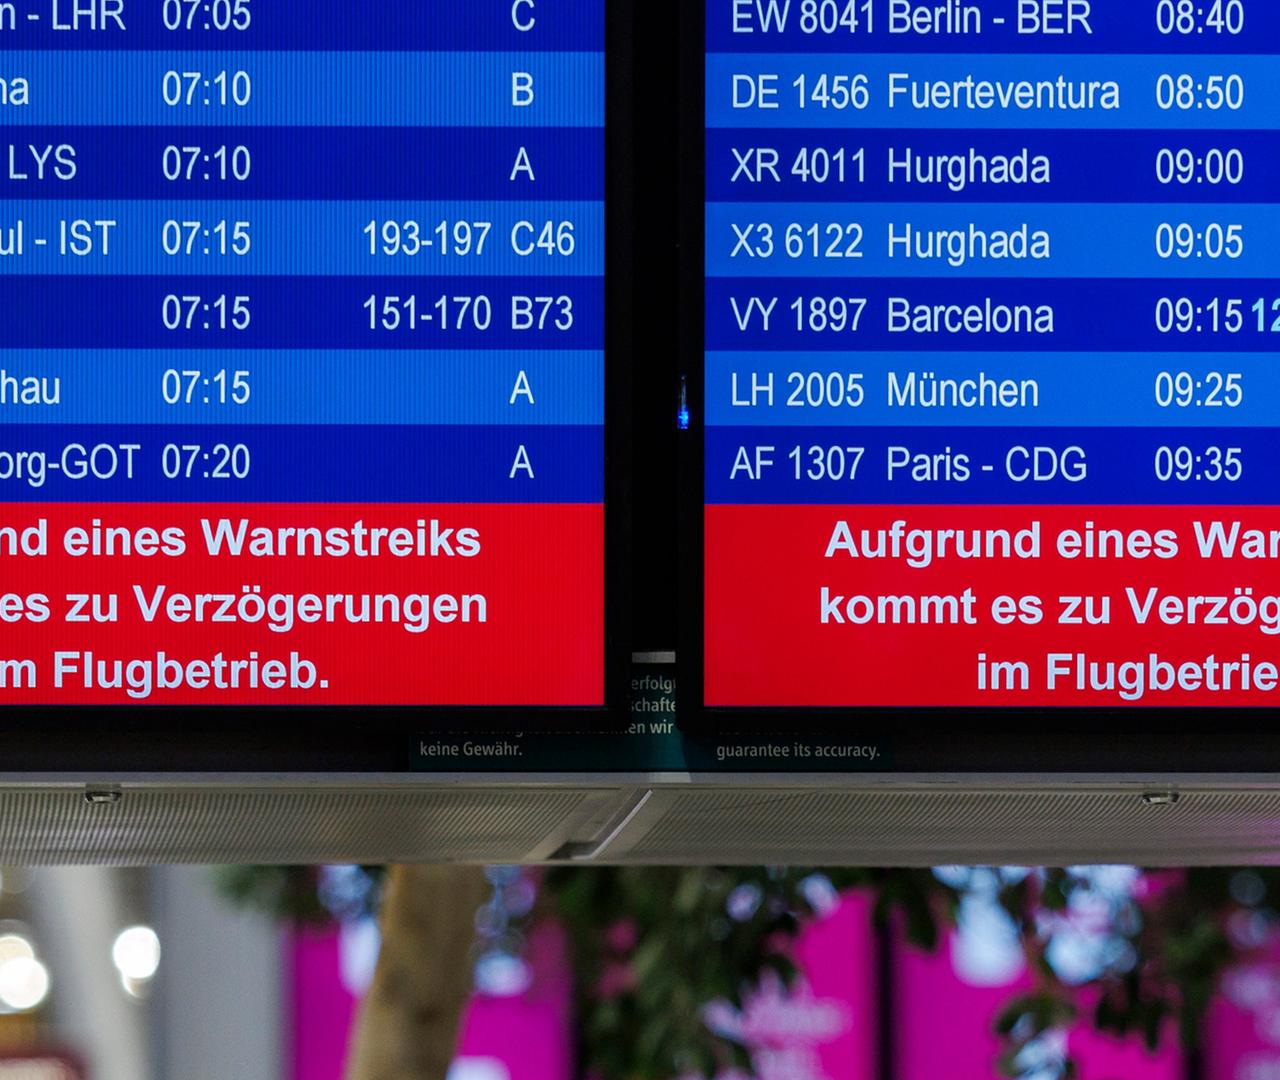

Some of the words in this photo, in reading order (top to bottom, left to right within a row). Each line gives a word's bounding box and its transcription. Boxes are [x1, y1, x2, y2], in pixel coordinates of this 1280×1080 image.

[162, 70, 251, 106] 07:10
[511, 71, 534, 107] B
[732, 74, 779, 109] DE
[793, 73, 869, 110] 1456
[888, 73, 1120, 110] Fuerteventura
[1156, 73, 1244, 110] 08:50
[730, 148, 781, 182] XR
[791, 147, 864, 183] 4011
[888, 147, 1050, 192] Hurghada
[1155, 148, 1244, 184] 09:00
[730, 222, 774, 258] X3
[785, 222, 863, 258] 6122
[888, 223, 1050, 267] Hurghada
[1155, 222, 1243, 259] 09:05
[162, 294, 251, 330] 07:15
[363, 294, 492, 331] 151-170
[511, 295, 573, 331] B73
[730, 297, 778, 331] VY
[790, 296, 867, 332] 1897
[888, 297, 1054, 333] Barcelona
[1155, 297, 1243, 333] 09:15
[162, 368, 251, 404] 07:15
[509, 370, 535, 404] A
[731, 372, 774, 406] LH
[786, 371, 864, 407] 2005
[887, 371, 1039, 408] München
[1155, 371, 1243, 407] 09:25
[162, 443, 250, 479] 07:20
[509, 444, 535, 479] A
[63, 518, 187, 557] eines
[200, 518, 481, 557] Warnstreiks
[824, 519, 1041, 569] Aufgrund
[1056, 520, 1179, 559] eines
[64, 593, 118, 623] zu
[132, 584, 487, 633] Verzögerungen
[820, 586, 977, 625] kommt
[991, 595, 1044, 625] es
[1057, 596, 1110, 625] zu
[54, 651, 329, 699] Flugbetrieb.
[977, 652, 1029, 690] im
[649, 719, 674, 735] wir
[419, 741, 460, 756] keine
[463, 740, 523, 756] Gewähr.
[716, 743, 790, 761] guarantee
[793, 742, 811, 758] its
[814, 744, 881, 761] accuracy.
